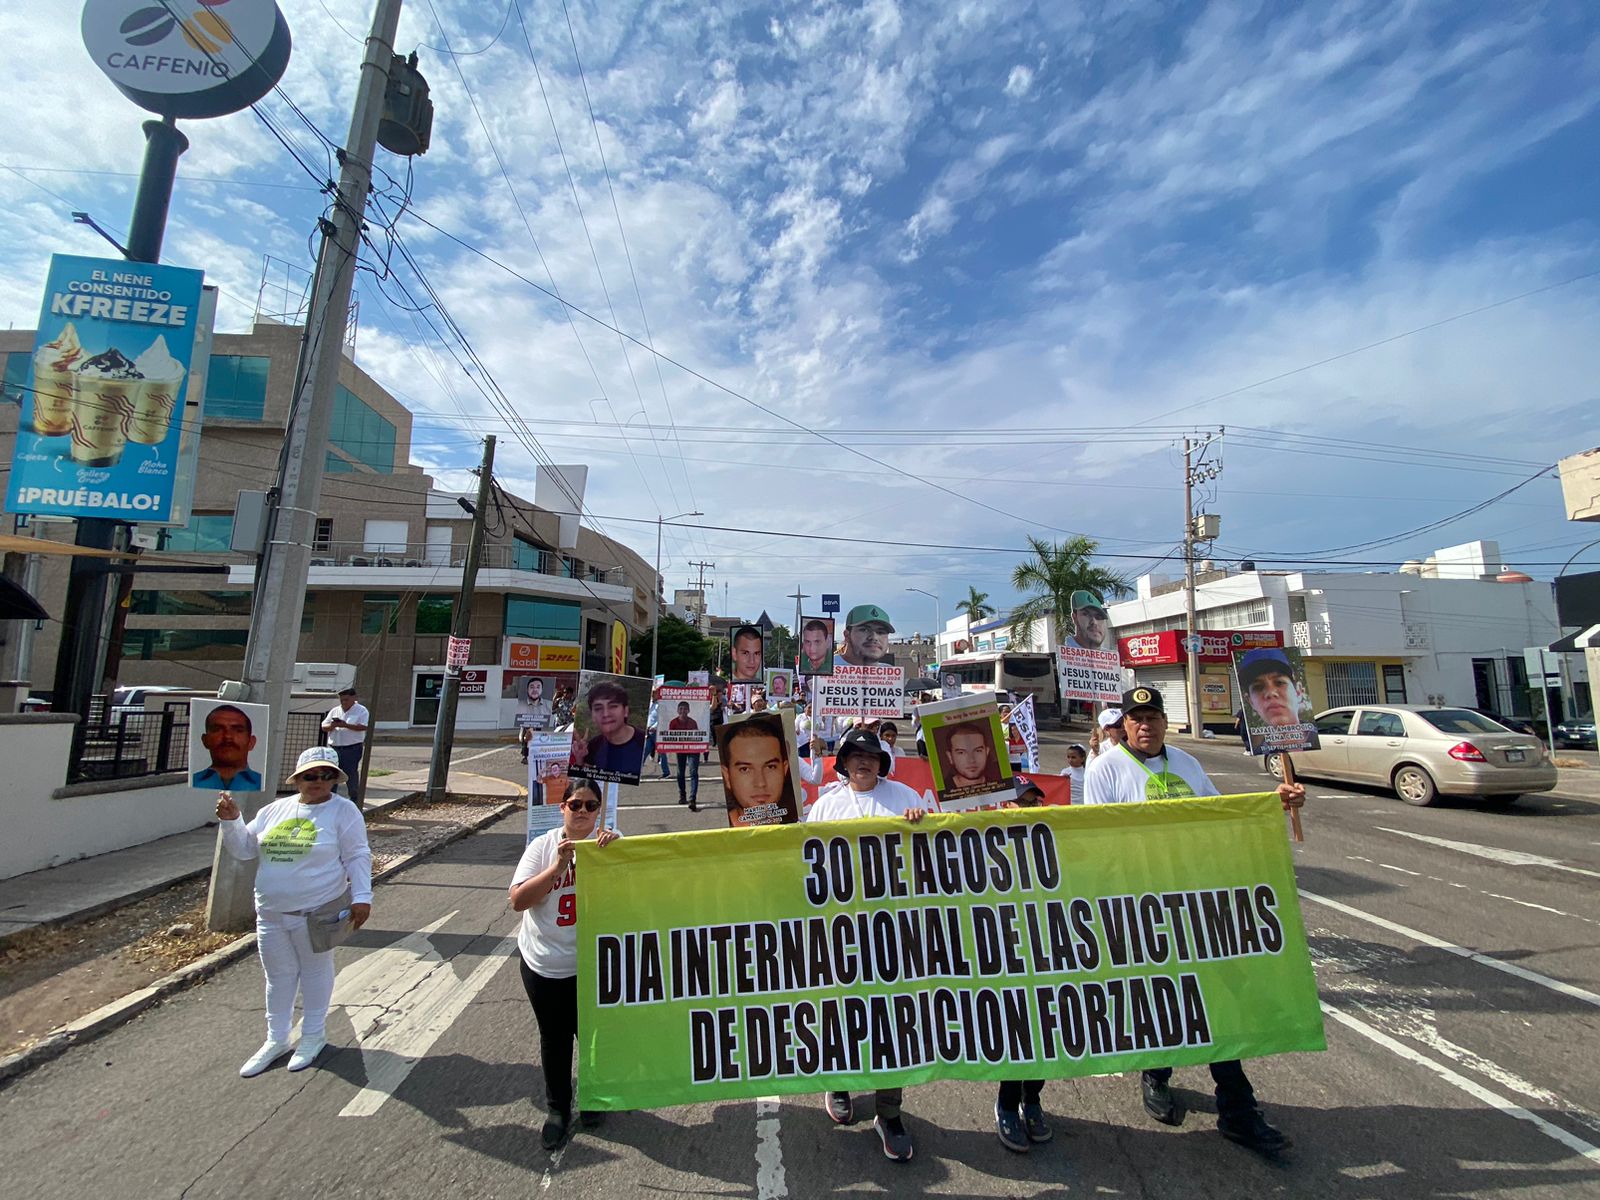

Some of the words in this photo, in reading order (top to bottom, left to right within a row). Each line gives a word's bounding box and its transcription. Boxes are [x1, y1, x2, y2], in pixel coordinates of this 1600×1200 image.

[107, 52, 230, 78] CAFFENIO
[92, 270, 108, 282] EL
[112, 272, 153, 286] NENE
[68, 281, 172, 301] CONSENTIDO
[51, 292, 189, 326] KFREEZE
[17, 486, 161, 511] ¡PRUÉBALO!
[545, 653, 577, 662] DHL
[1060, 646, 1118, 661] DESAPARECIDO
[833, 666, 902, 676] SAPARECIDO
[1062, 667, 1090, 679] JESUS
[1092, 670, 1120, 682] TOMAS
[459, 683, 484, 692] nabit
[819, 686, 858, 696] JESUS
[861, 687, 902, 697] TOMAS
[1067, 679, 1092, 690] FELIX
[1094, 682, 1117, 692] FELIX
[825, 697, 859, 706] FELIX
[863, 698, 896, 708] FELIX
[860, 708, 869, 716] TU
[804, 836, 854, 907] 30
[858, 831, 910, 900] DE
[911, 822, 1060, 897] AGOSTO
[556, 893, 577, 927] 9
[596, 931, 665, 1007] DIA
[670, 905, 971, 1000] INTERNACIONAL
[970, 903, 1027, 977] DE
[1024, 897, 1100, 975] LAS
[1096, 884, 1286, 968] VICTIMAS
[689, 1007, 742, 1085] DE
[744, 985, 1036, 1079] DESAPARICION
[1034, 972, 1213, 1063] FORZADA
